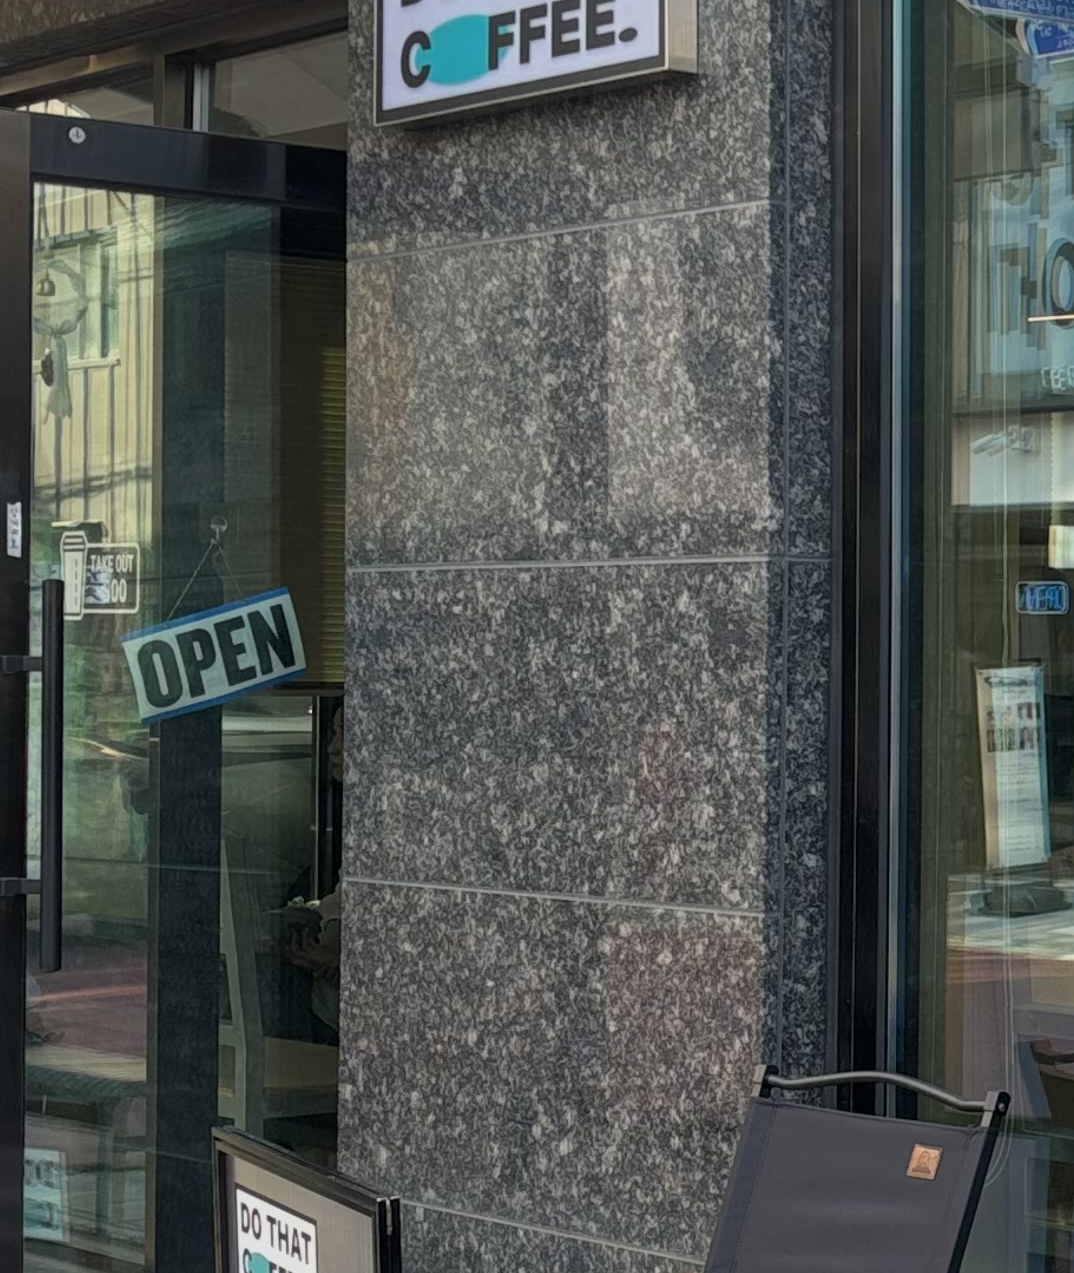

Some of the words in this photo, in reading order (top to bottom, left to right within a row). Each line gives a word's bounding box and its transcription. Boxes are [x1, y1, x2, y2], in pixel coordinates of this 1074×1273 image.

[90, 554, 114, 573] TAKE
[115, 553, 134, 573] OUT
[137, 604, 296, 708] OPEN
[241, 1202, 262, 1240] DO
[266, 1214, 312, 1265] THAT
